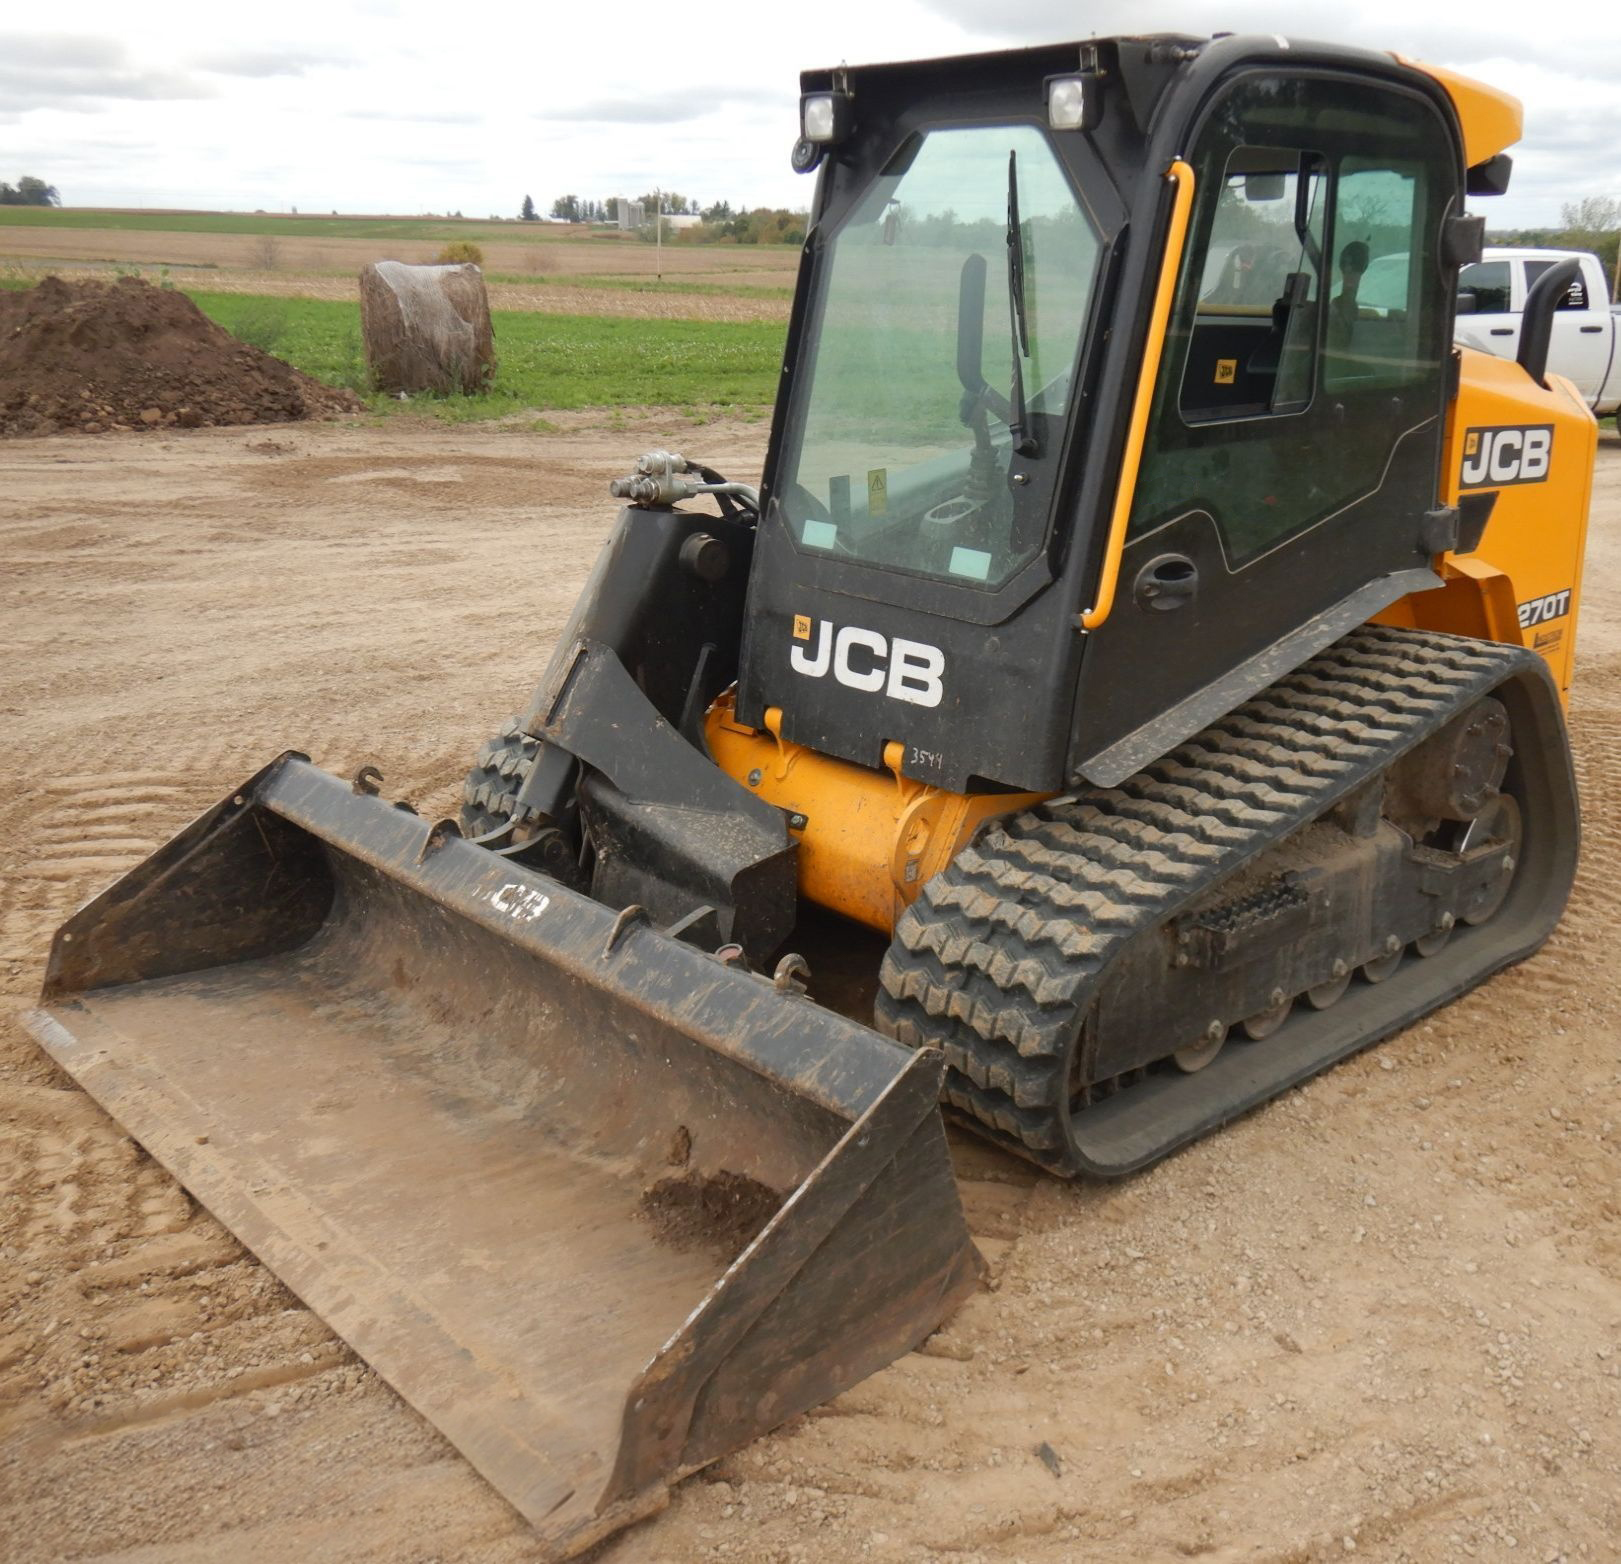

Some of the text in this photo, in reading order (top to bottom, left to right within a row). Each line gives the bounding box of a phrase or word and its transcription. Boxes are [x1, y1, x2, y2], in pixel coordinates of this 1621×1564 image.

[1462, 429, 1551, 484] JCB
[1517, 590, 1570, 629] 270T
[790, 619, 946, 708] JCB
